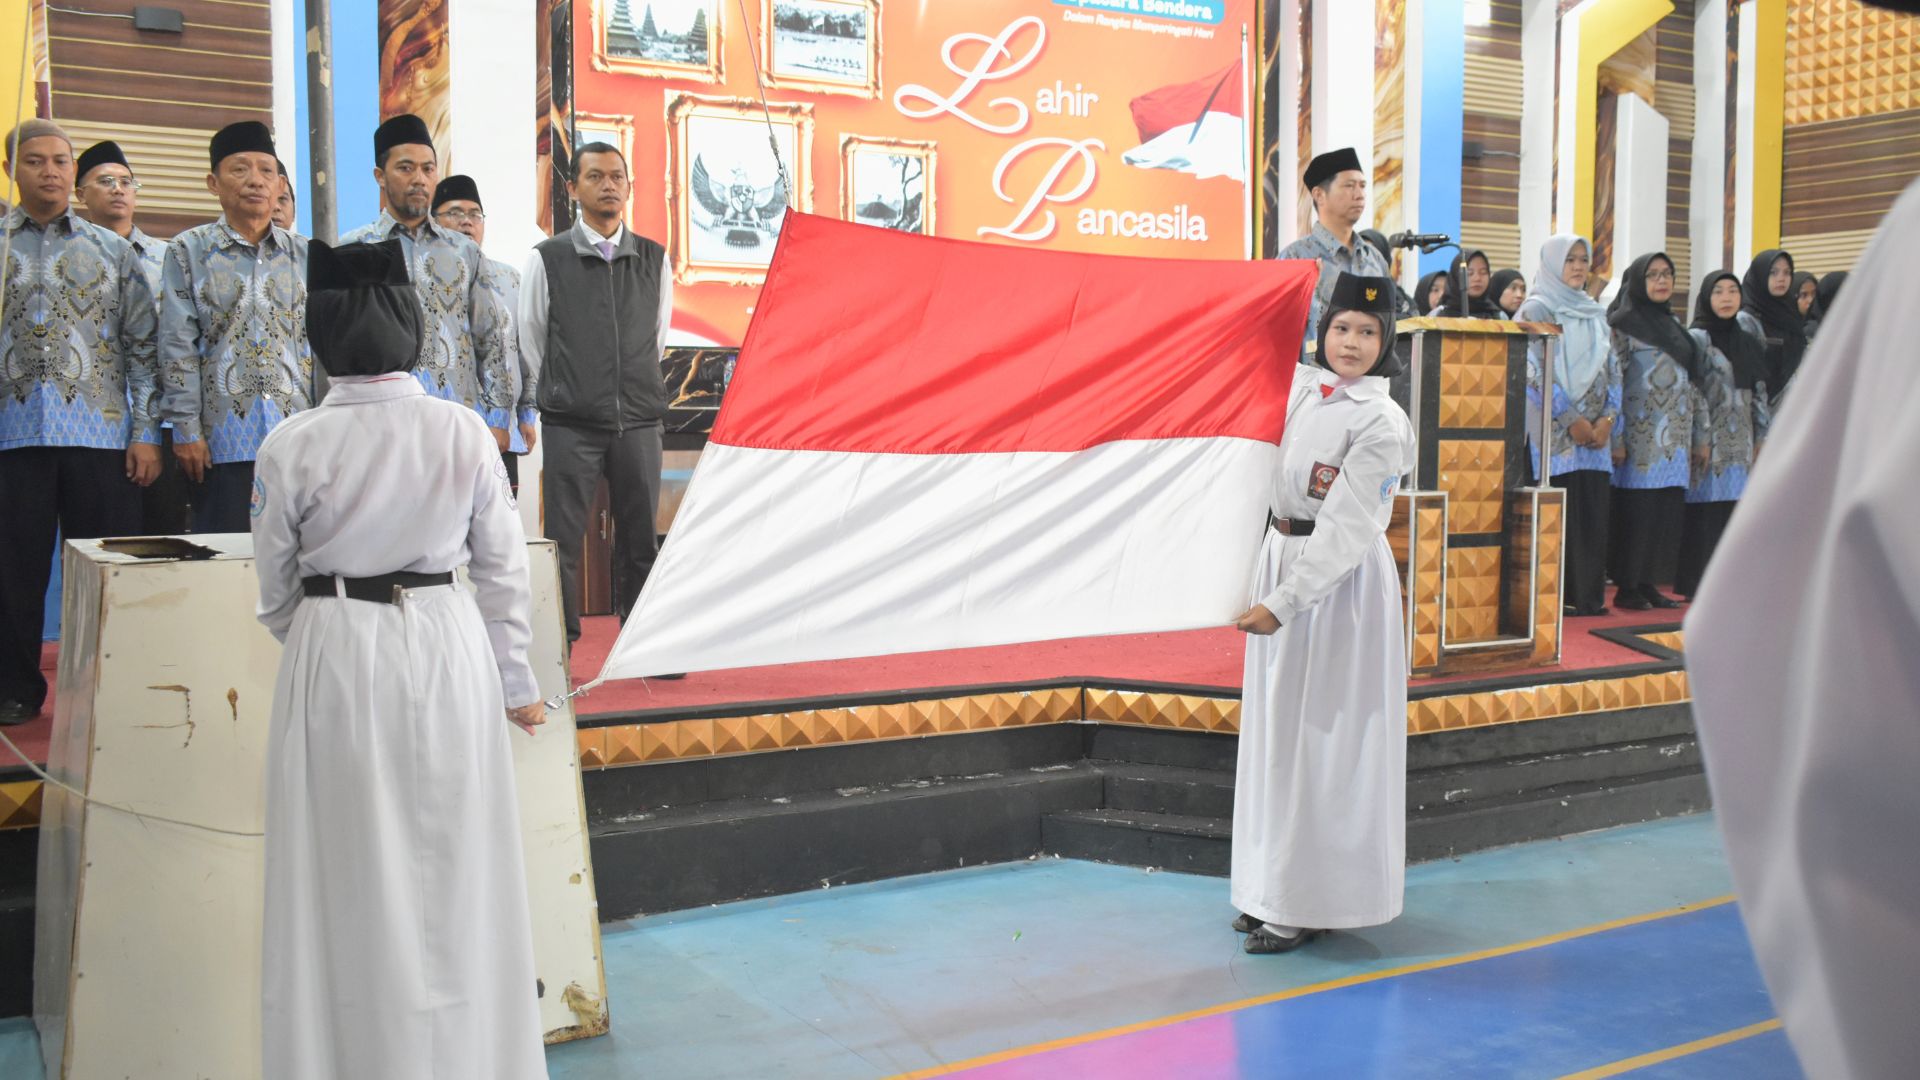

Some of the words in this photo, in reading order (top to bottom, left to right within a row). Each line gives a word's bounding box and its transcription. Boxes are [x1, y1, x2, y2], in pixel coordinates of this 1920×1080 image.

[1063, 9, 1095, 24] Dalam
[1096, 13, 1131, 30] Rangka
[1132, 18, 1194, 38] Memperingati
[1194, 26, 1215, 40] Hari
[1068, 0, 1139, 11] pacara
[1143, 0, 1213, 20] Bendera
[893, 15, 1099, 134] Lahir
[976, 137, 1209, 242] Pancasila
